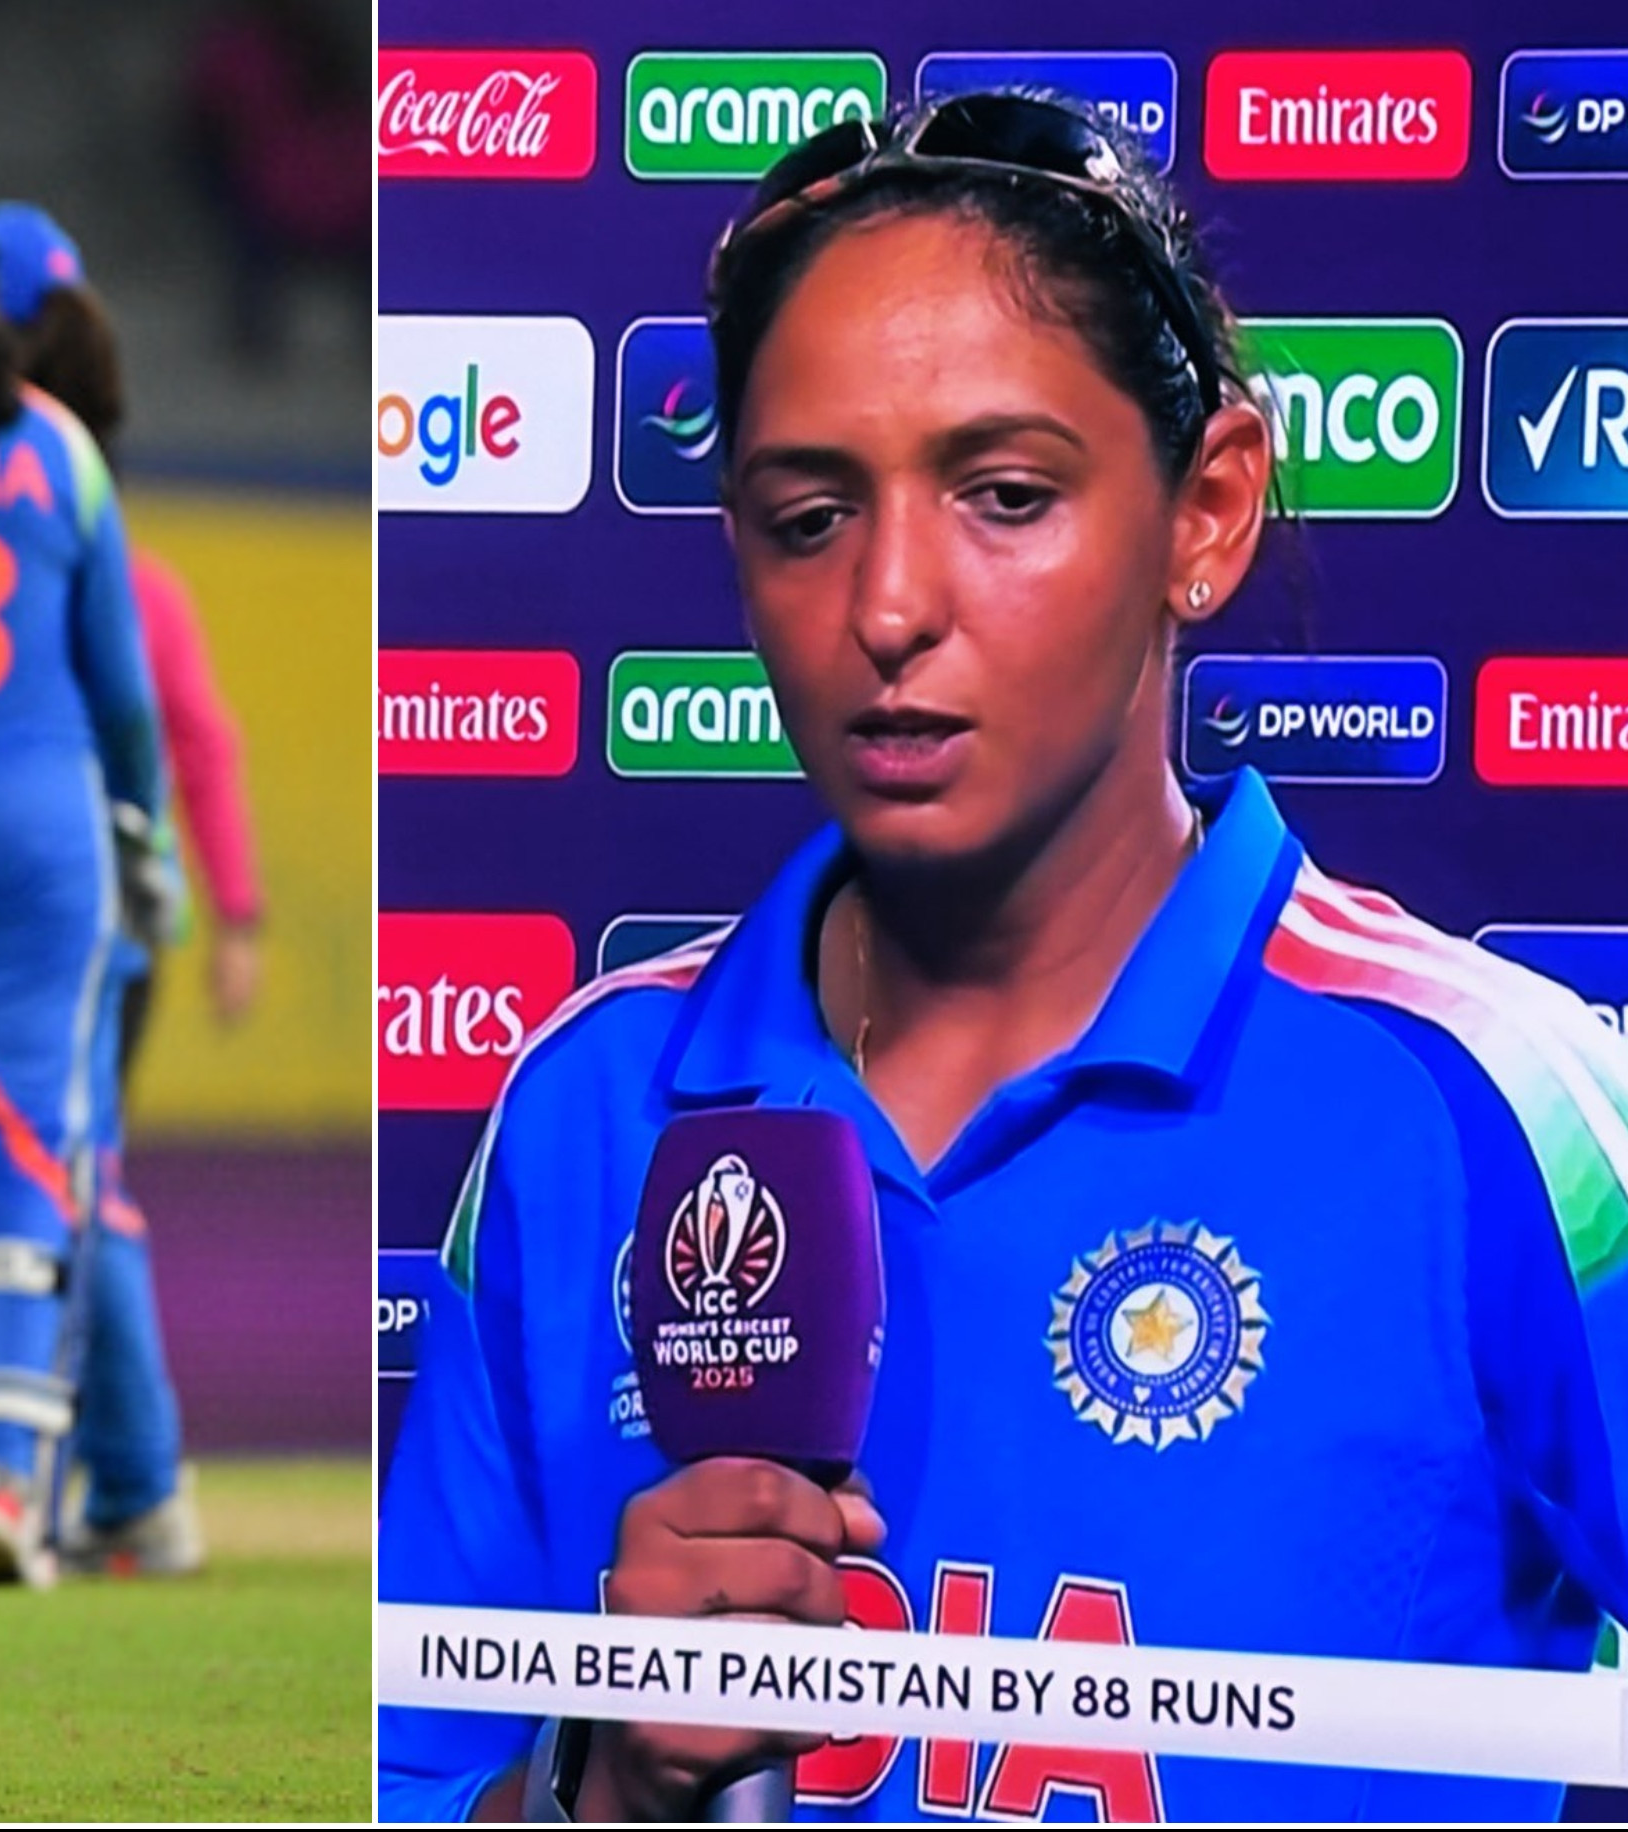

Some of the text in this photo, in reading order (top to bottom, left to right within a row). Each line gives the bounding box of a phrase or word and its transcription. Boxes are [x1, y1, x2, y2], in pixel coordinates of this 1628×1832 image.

[378, 69, 562, 157] Coca-Cola
[1238, 84, 1438, 145] Emirates
[1577, 99, 1625, 133] DP
[378, 363, 521, 486] ogle
[378, 682, 548, 742] mirates
[1259, 704, 1434, 739] DP WORLD
[695, 1289, 738, 1316] ICC
[723, 1317, 791, 1335] CRICKET
[653, 1336, 799, 1366] WORLD CUP
